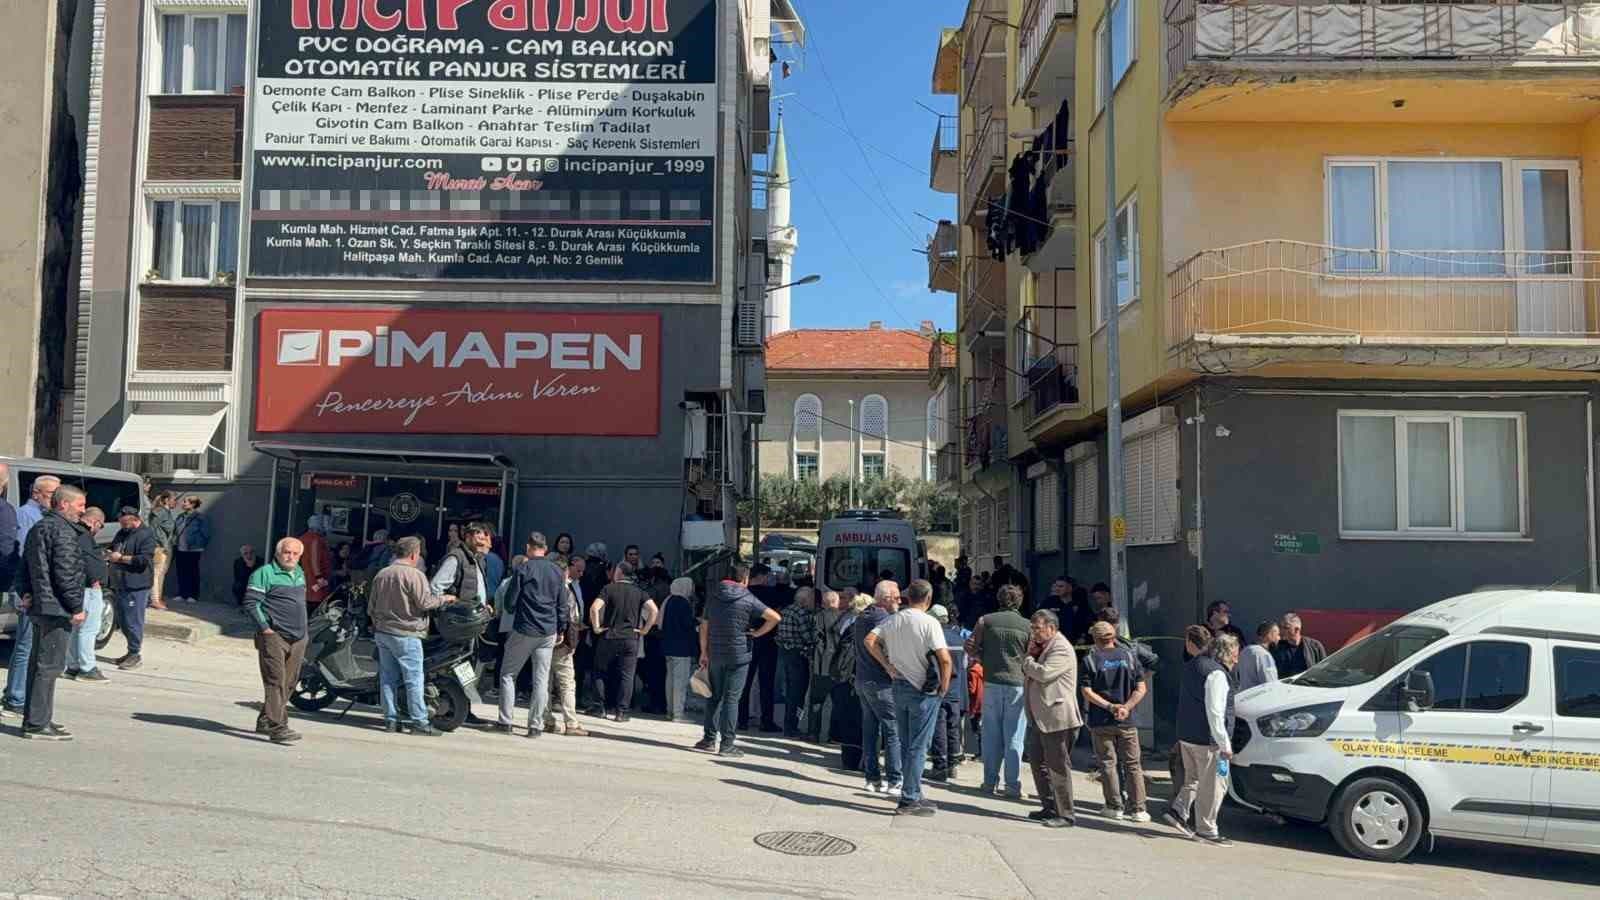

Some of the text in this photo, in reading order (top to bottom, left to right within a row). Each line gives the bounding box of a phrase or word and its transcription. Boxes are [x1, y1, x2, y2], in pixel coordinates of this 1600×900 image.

[298, 36, 348, 53] PVC
[355, 34, 485, 54] DOĞRAMA
[506, 39, 563, 55] CAM
[571, 40, 674, 56] BALKON
[284, 57, 686, 80] OTOMATİK PANJUR SİSTEMLERİ
[263, 85, 326, 97] Demonte
[331, 86, 362, 97] Cam
[367, 86, 416, 98] Balkon
[429, 87, 464, 98] Plise
[468, 87, 525, 99] Sineklik
[538, 88, 573, 100] Plise
[577, 89, 619, 101] Perde
[632, 90, 705, 104] Duşakabin
[271, 100, 307, 114] Çelik
[311, 102, 342, 113] Kapı
[356, 102, 408, 114] Menfez
[421, 103, 486, 115] Laminant
[492, 104, 534, 116] Parke
[546, 105, 627, 118] Alüminyum
[632, 106, 696, 118] Korkuluk
[316, 118, 369, 129] Giyotin
[374, 118, 407, 130] Cam
[413, 119, 464, 130] Balkon
[478, 120, 539, 132] Anahtar
[544, 121, 594, 133] Teslim
[600, 122, 651, 134] Tadilat
[265, 132, 305, 145] Panjur
[309, 133, 348, 145] Tamiri
[352, 137, 365, 145] ve
[369, 134, 410, 146] Bakımı
[421, 135, 476, 147] Otomatik
[480, 136, 512, 148] Garaj
[516, 137, 552, 149] Kapısı
[567, 138, 588, 151] Saç
[592, 138, 636, 150] Kepenk
[640, 139, 701, 150] Sistemleri
[262, 154, 443, 170] www.incipanjur.com
[564, 159, 705, 176] incipanjur_1999
[281, 224, 317, 234] Kumla
[320, 224, 346, 234] Mah.
[350, 224, 388, 235] Hizmet
[391, 225, 417, 236] Cad.
[420, 226, 455, 236] Fatma
[480, 227, 502, 239] Apt.
[505, 228, 521, 238] 11.
[532, 228, 548, 238] 12.
[551, 228, 583, 239] Durak
[586, 229, 615, 239] Arası
[618, 229, 686, 242] Küçükkumla
[266, 237, 302, 247] Kumla
[305, 237, 332, 248] Mah.
[347, 238, 376, 249] Ozan
[380, 238, 397, 249] Sk.
[413, 239, 451, 251] Seçkin
[494, 240, 525, 250] Sitesi
[561, 241, 594, 252] Durak
[596, 242, 625, 252] Arası
[631, 242, 700, 254] Küçükkumla
[344, 252, 624, 266] Halitpaşa Mah. Kumla Cad. Acar Apt. No: 2 Gemlik
[316, 391, 438, 426] Pencereye
[533, 373, 600, 399] Veren
[835, 533, 898, 544] AMBULANS
[1342, 743, 1369, 752] OLAY
[1494, 752, 1520, 761] OLAY
